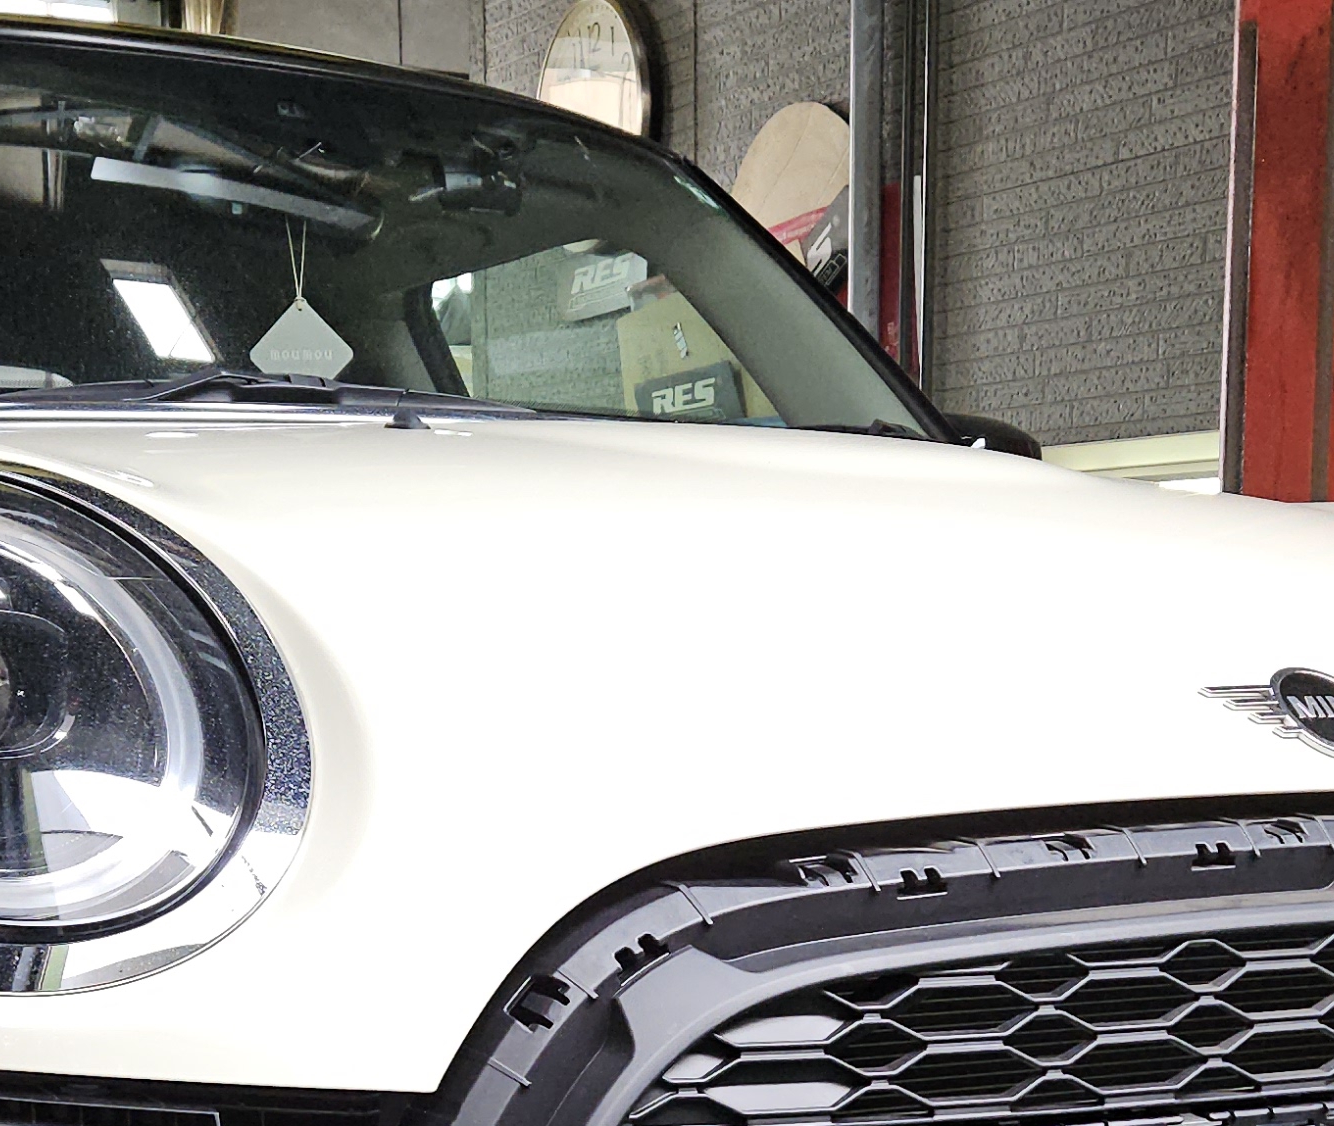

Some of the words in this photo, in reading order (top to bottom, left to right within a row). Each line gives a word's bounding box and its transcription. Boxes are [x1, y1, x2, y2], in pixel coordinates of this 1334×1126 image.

[570, 252, 631, 295] RES
[269, 348, 334, 361] moumou
[651, 377, 716, 416] RES
